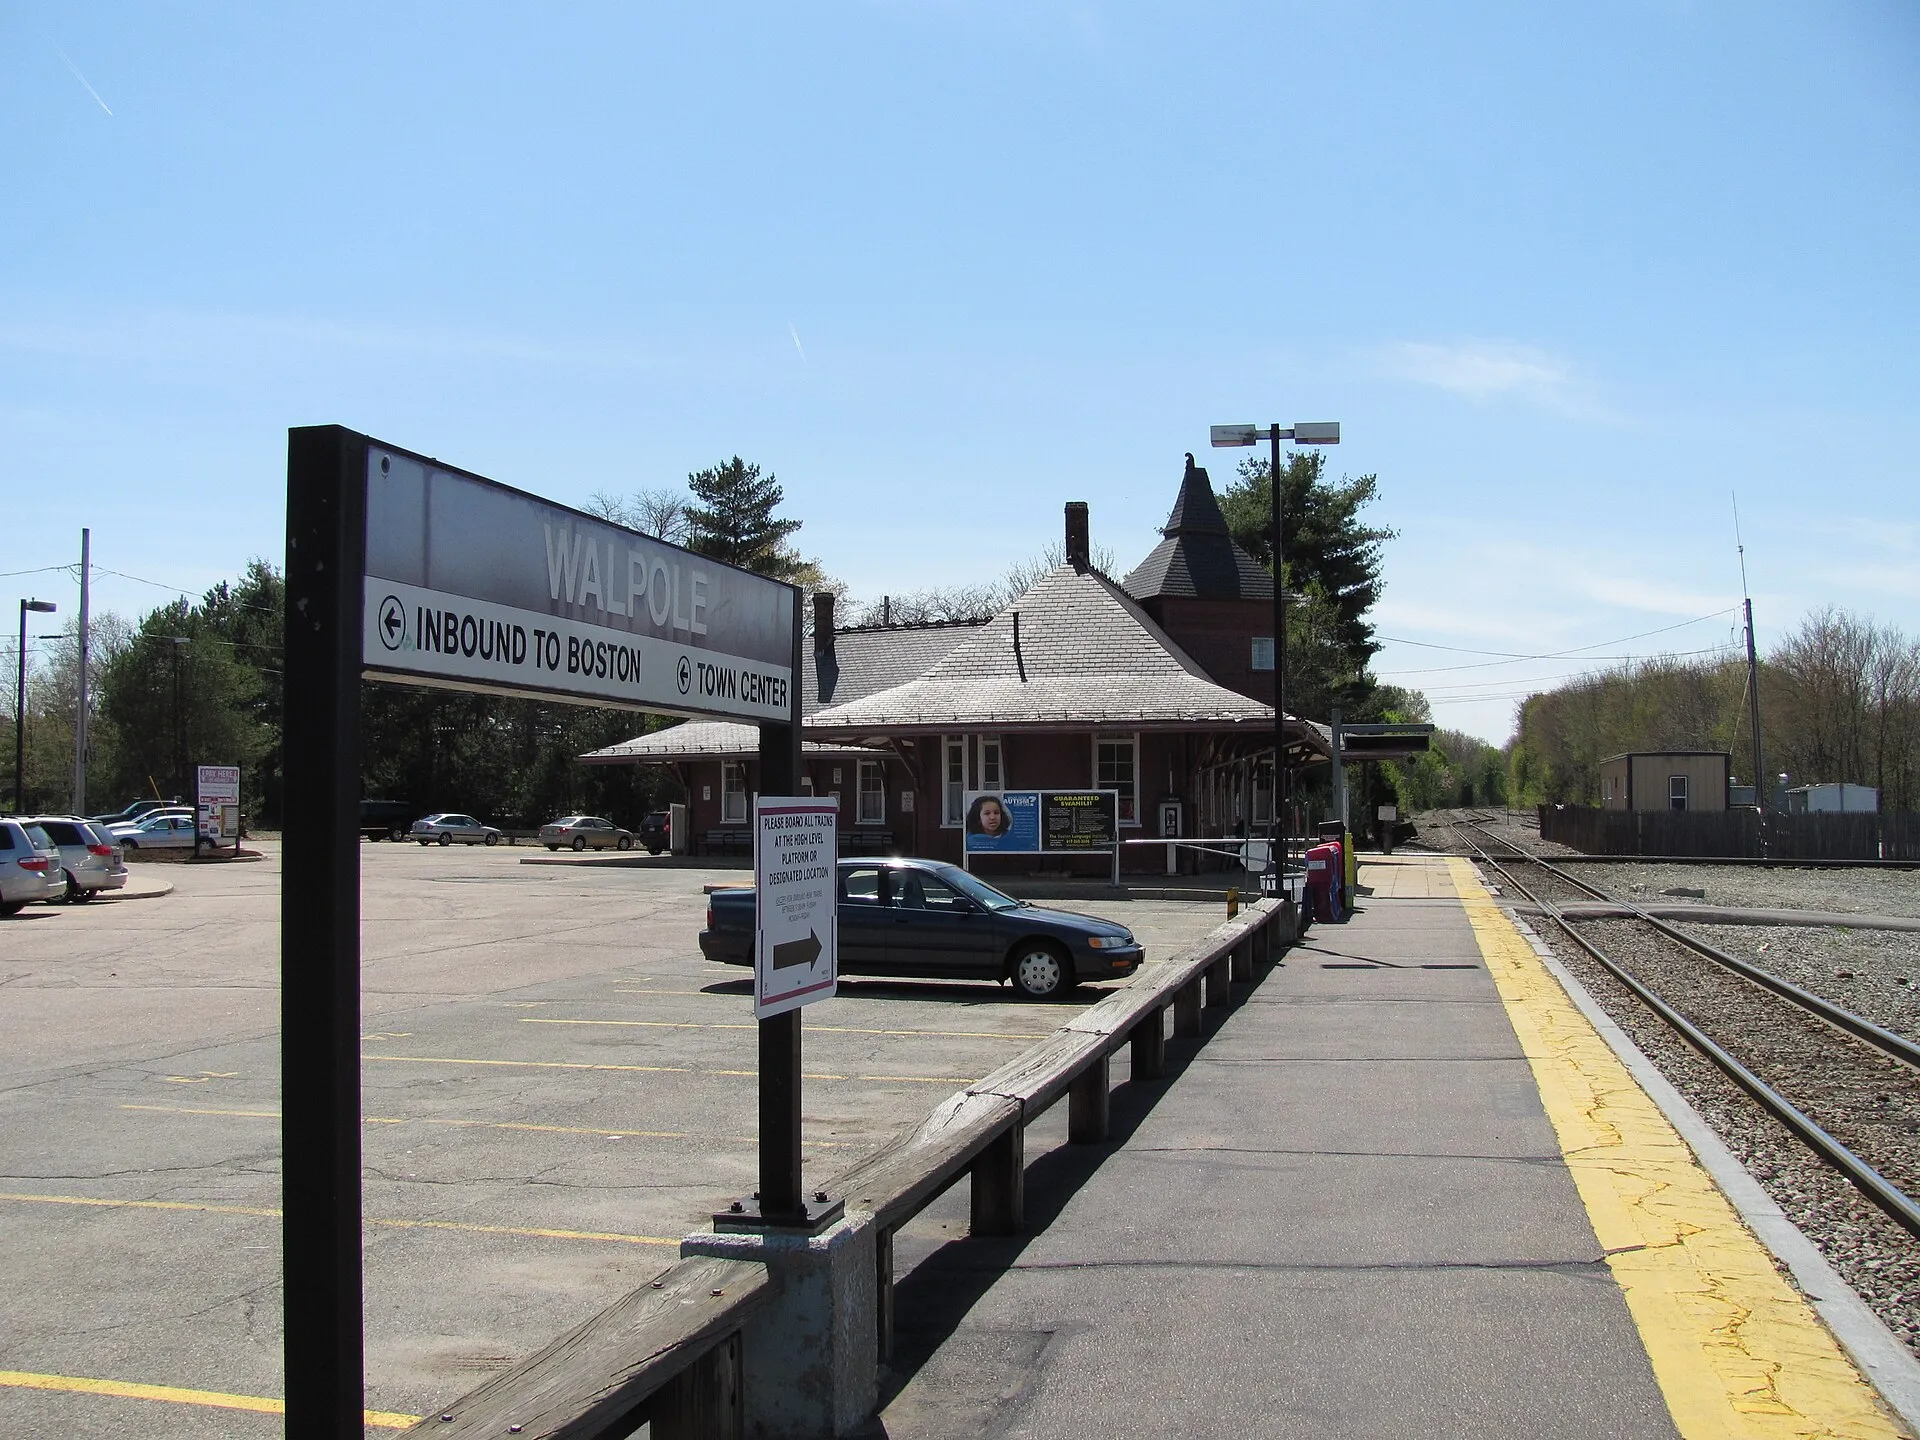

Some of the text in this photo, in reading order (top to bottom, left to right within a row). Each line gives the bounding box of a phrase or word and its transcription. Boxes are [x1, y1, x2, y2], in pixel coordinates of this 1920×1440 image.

[544, 523, 708, 635] WALPOLE
[416, 606, 641, 683] INBOUND TO BOSTON
[697, 662, 787, 708] TOWN CENTER
[764, 815, 833, 830] PLEASE BOARD ALL TRAINS
[774, 832, 824, 848] AT THE HIGH LEVEL
[781, 850, 818, 865] PLATFORM OR
[769, 866, 829, 886] DESIGNATED LOCATION
